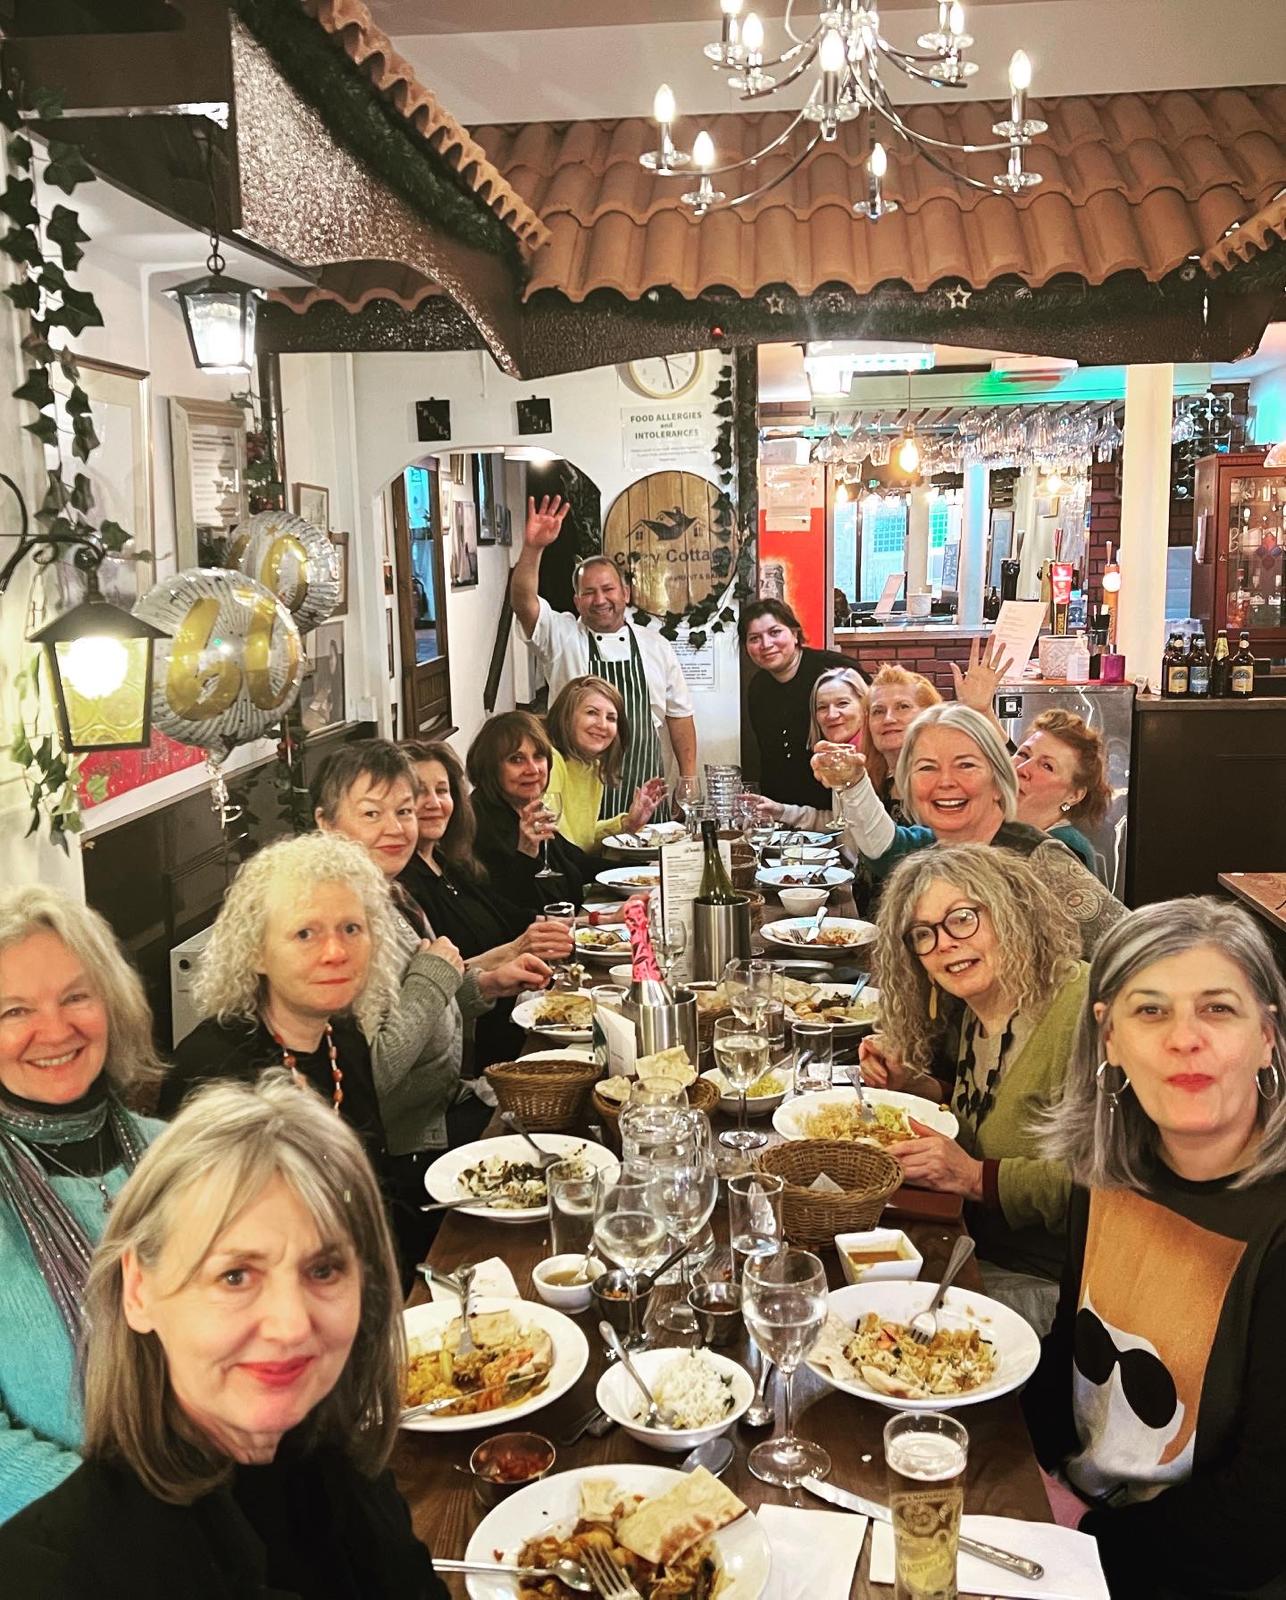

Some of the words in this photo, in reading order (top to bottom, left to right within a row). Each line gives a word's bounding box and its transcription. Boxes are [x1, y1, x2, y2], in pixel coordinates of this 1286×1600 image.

[630, 414, 655, 423] FOOD
[656, 411, 703, 421] ALLERGIES
[635, 428, 699, 440] INTOLERANCES
[165, 587, 300, 721] 60
